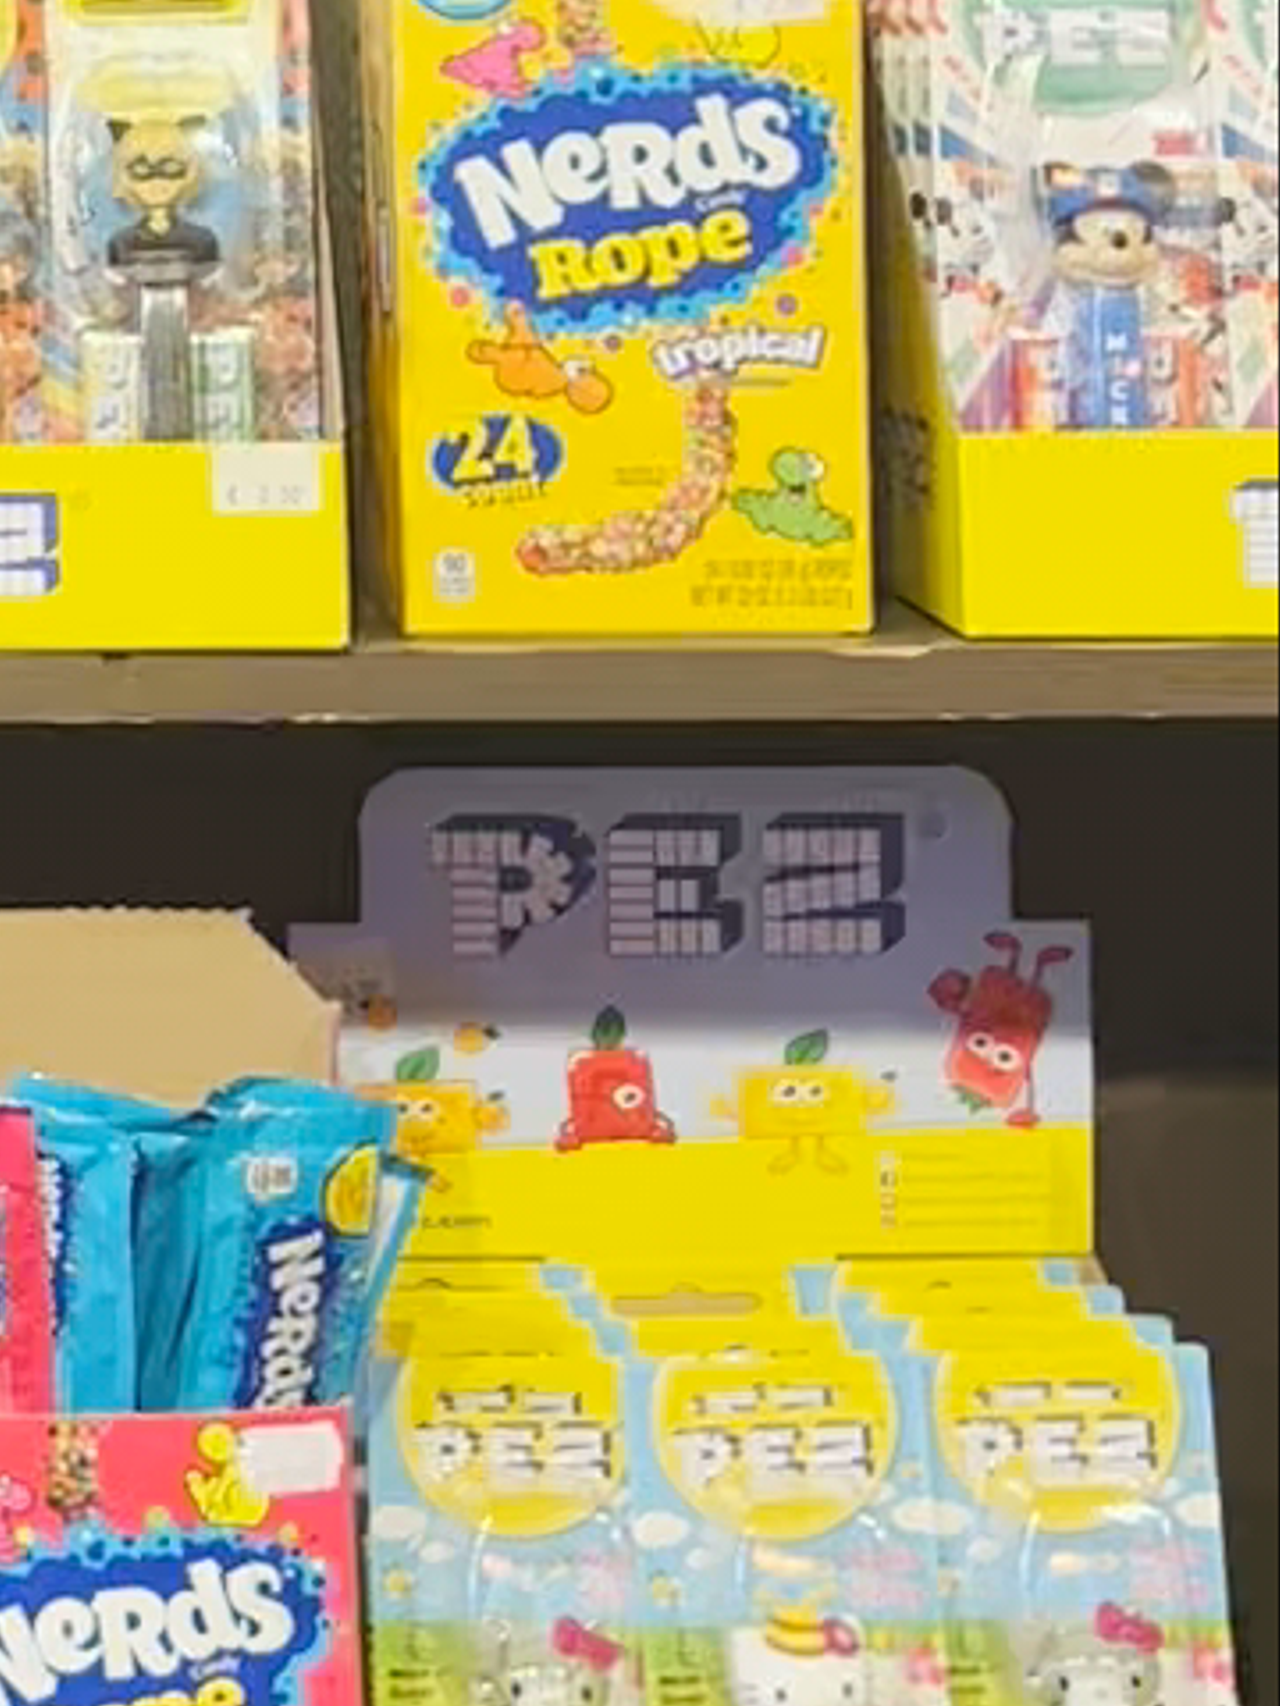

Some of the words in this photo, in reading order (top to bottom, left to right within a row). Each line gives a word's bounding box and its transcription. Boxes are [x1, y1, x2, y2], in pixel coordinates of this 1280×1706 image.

[527, 208, 752, 301] Rope
[652, 326, 827, 378] tropical
[443, 415, 539, 486] 24
[432, 812, 906, 957] PEZ
